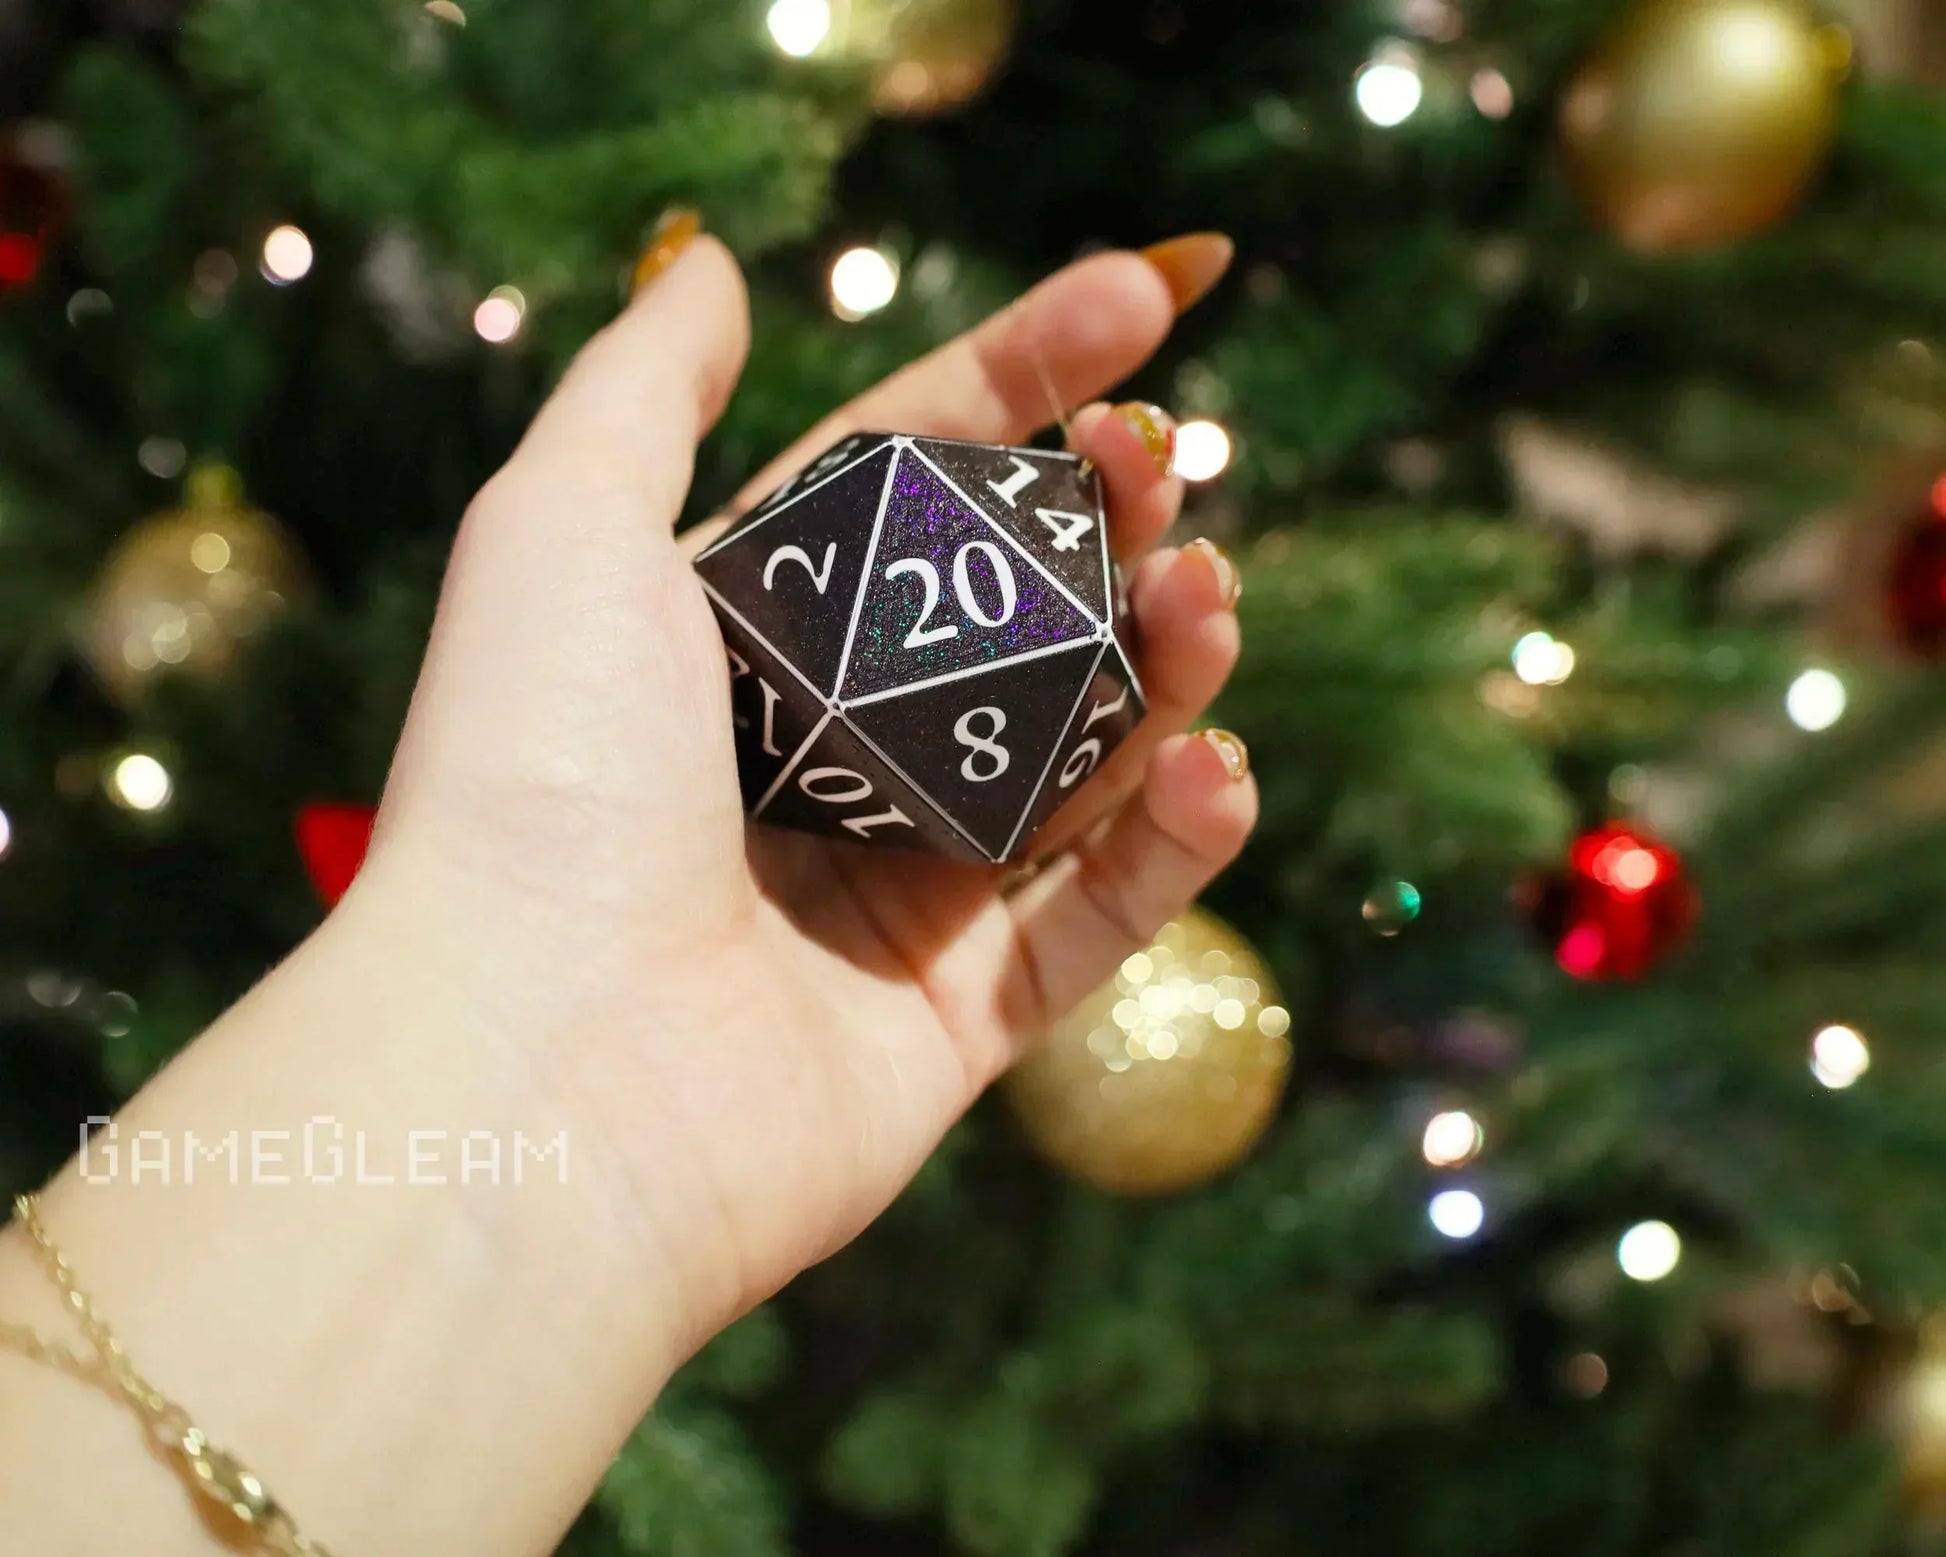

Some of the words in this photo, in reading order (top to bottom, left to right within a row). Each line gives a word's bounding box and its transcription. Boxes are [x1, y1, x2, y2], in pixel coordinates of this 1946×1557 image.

[985, 455, 1095, 552] 14
[763, 541, 838, 594] 2
[884, 541, 1018, 649] 20
[953, 705, 1010, 782] 8
[798, 766, 916, 838] 10
